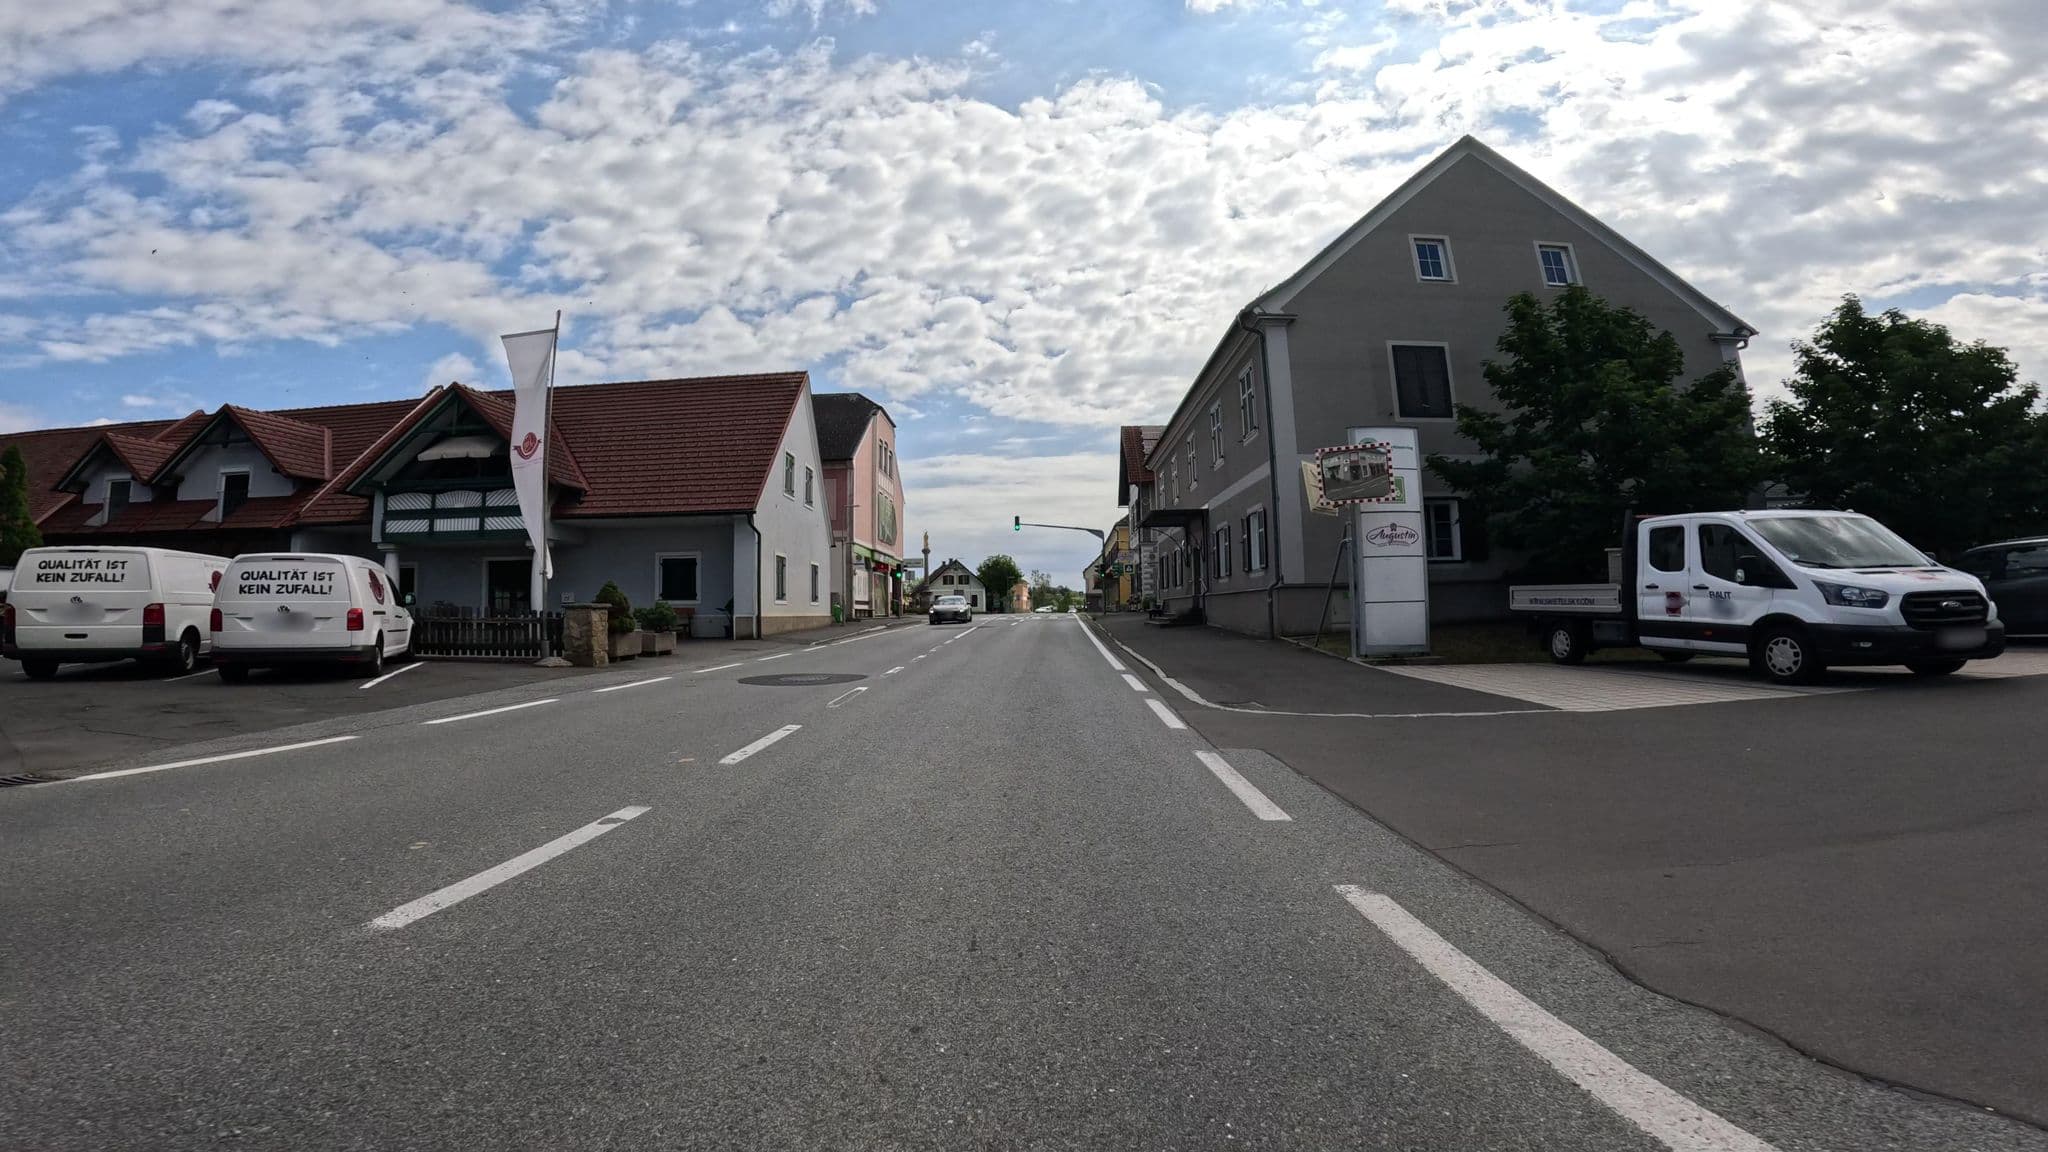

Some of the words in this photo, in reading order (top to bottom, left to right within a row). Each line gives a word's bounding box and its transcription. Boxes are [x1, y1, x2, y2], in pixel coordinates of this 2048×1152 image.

[1369, 529, 1416, 544] Augustin
[38, 558, 101, 570] QUALITÄT
[106, 560, 128, 570] IST
[36, 572, 65, 583] KEIN
[70, 572, 125, 583] ZUFALL!
[240, 568, 308, 581] QUALITÄT
[313, 571, 335, 582] IST
[239, 583, 271, 595] KEIN
[275, 584, 332, 595] ZUFALL!
